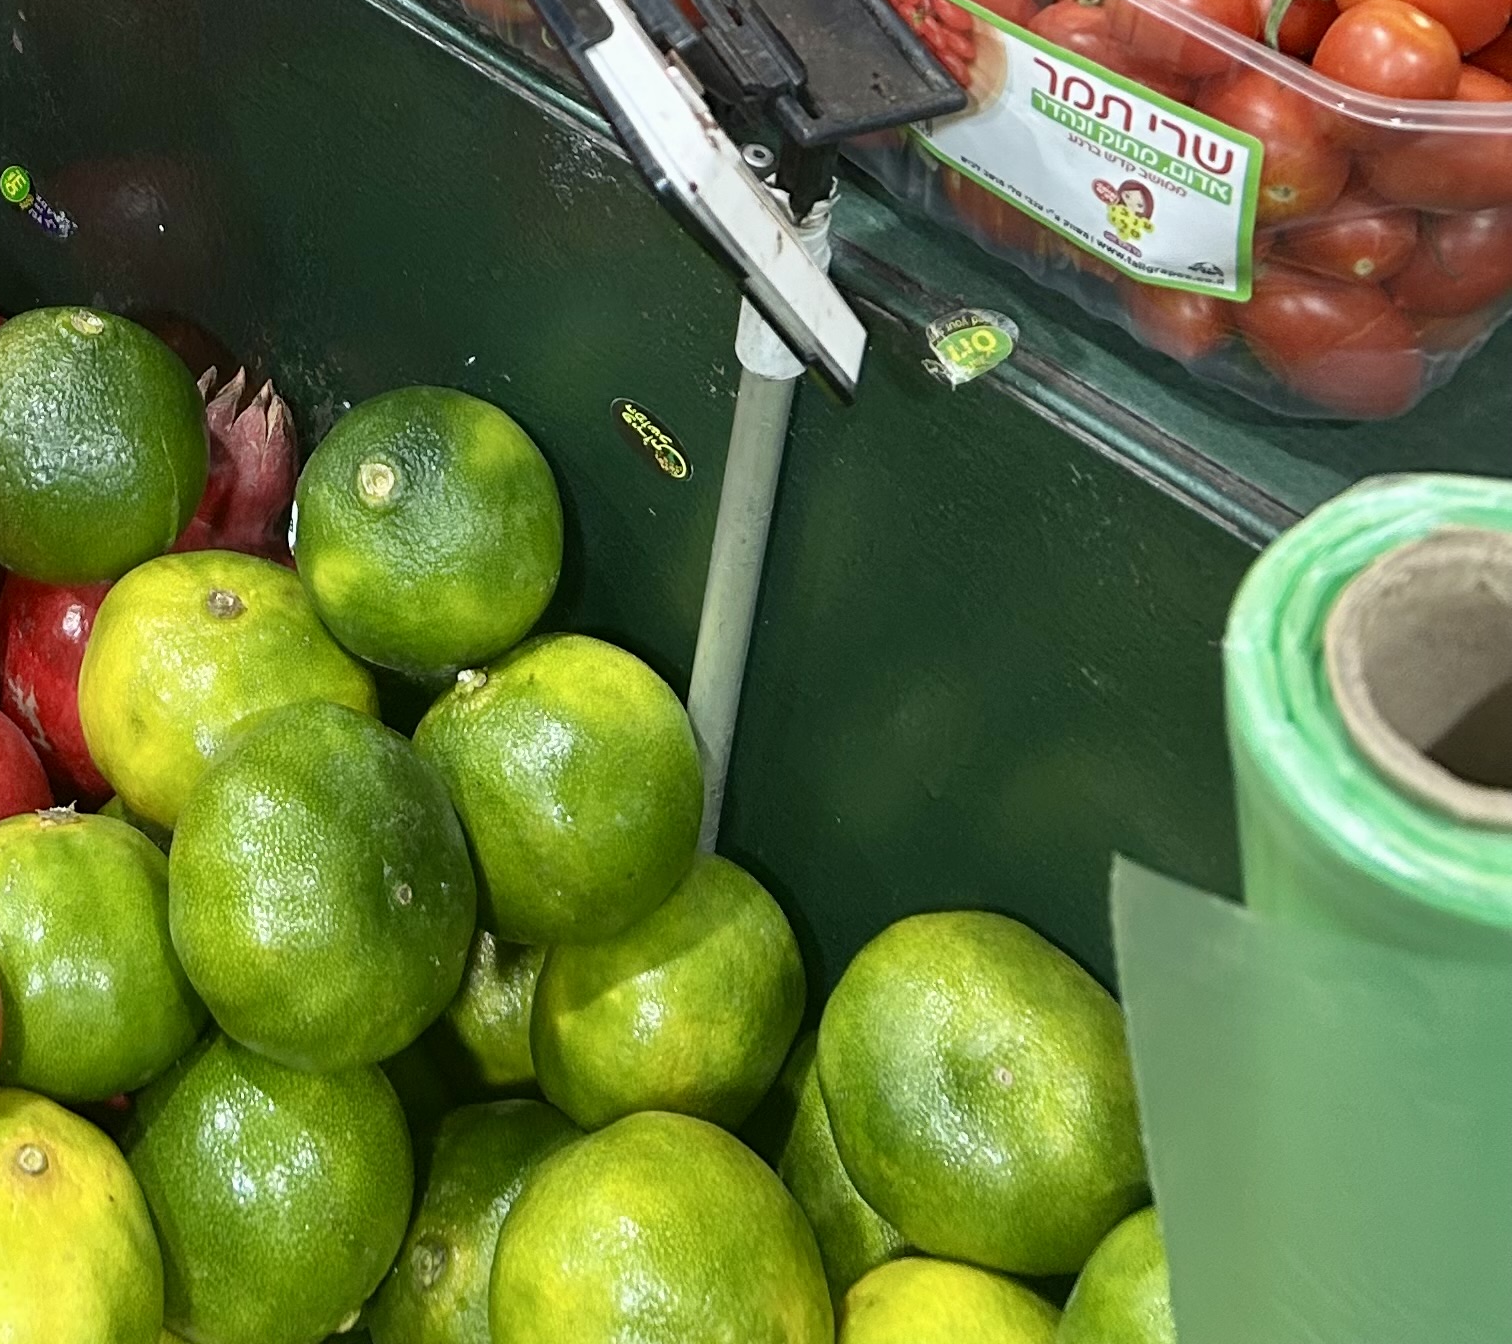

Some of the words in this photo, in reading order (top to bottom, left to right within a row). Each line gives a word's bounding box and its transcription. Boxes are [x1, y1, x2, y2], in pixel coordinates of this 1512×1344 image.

[1034, 57, 1132, 131] תמר
[1037, 96, 1092, 136] ונהדר
[1099, 130, 1157, 165] מתוק
[1149, 114, 1233, 174] שרי
[1163, 164, 1230, 197] אדום,
